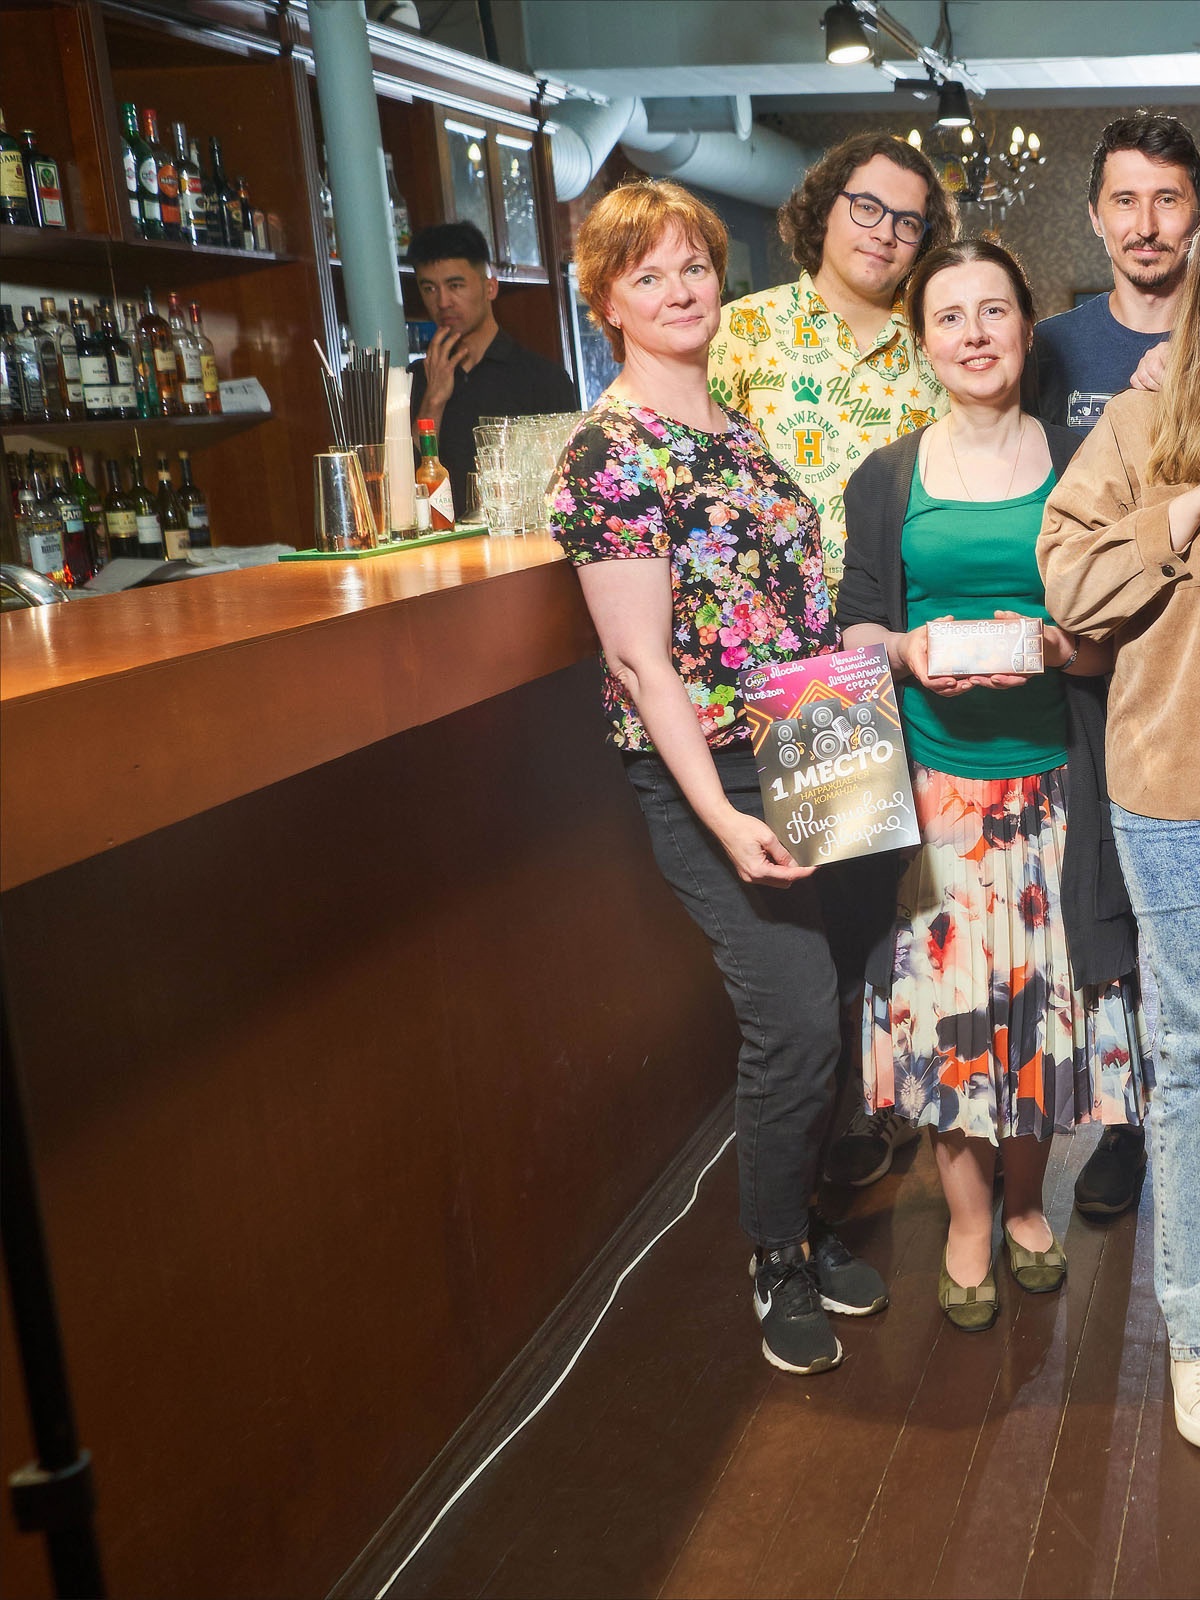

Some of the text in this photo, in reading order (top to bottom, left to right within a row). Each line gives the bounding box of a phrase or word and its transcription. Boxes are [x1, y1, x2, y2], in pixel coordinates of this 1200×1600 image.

[776, 410, 840, 440] HAWKINS
[793, 429, 825, 467] H
[780, 458, 841, 484] HIGH SCHOOL
[930, 621, 1005, 637] Schogetten
[771, 740, 893, 801] 1 МЕСТО
[800, 770, 869, 800] НАГРАЖДАЕТСЯ
[814, 784, 858, 805] КОМАНДА
